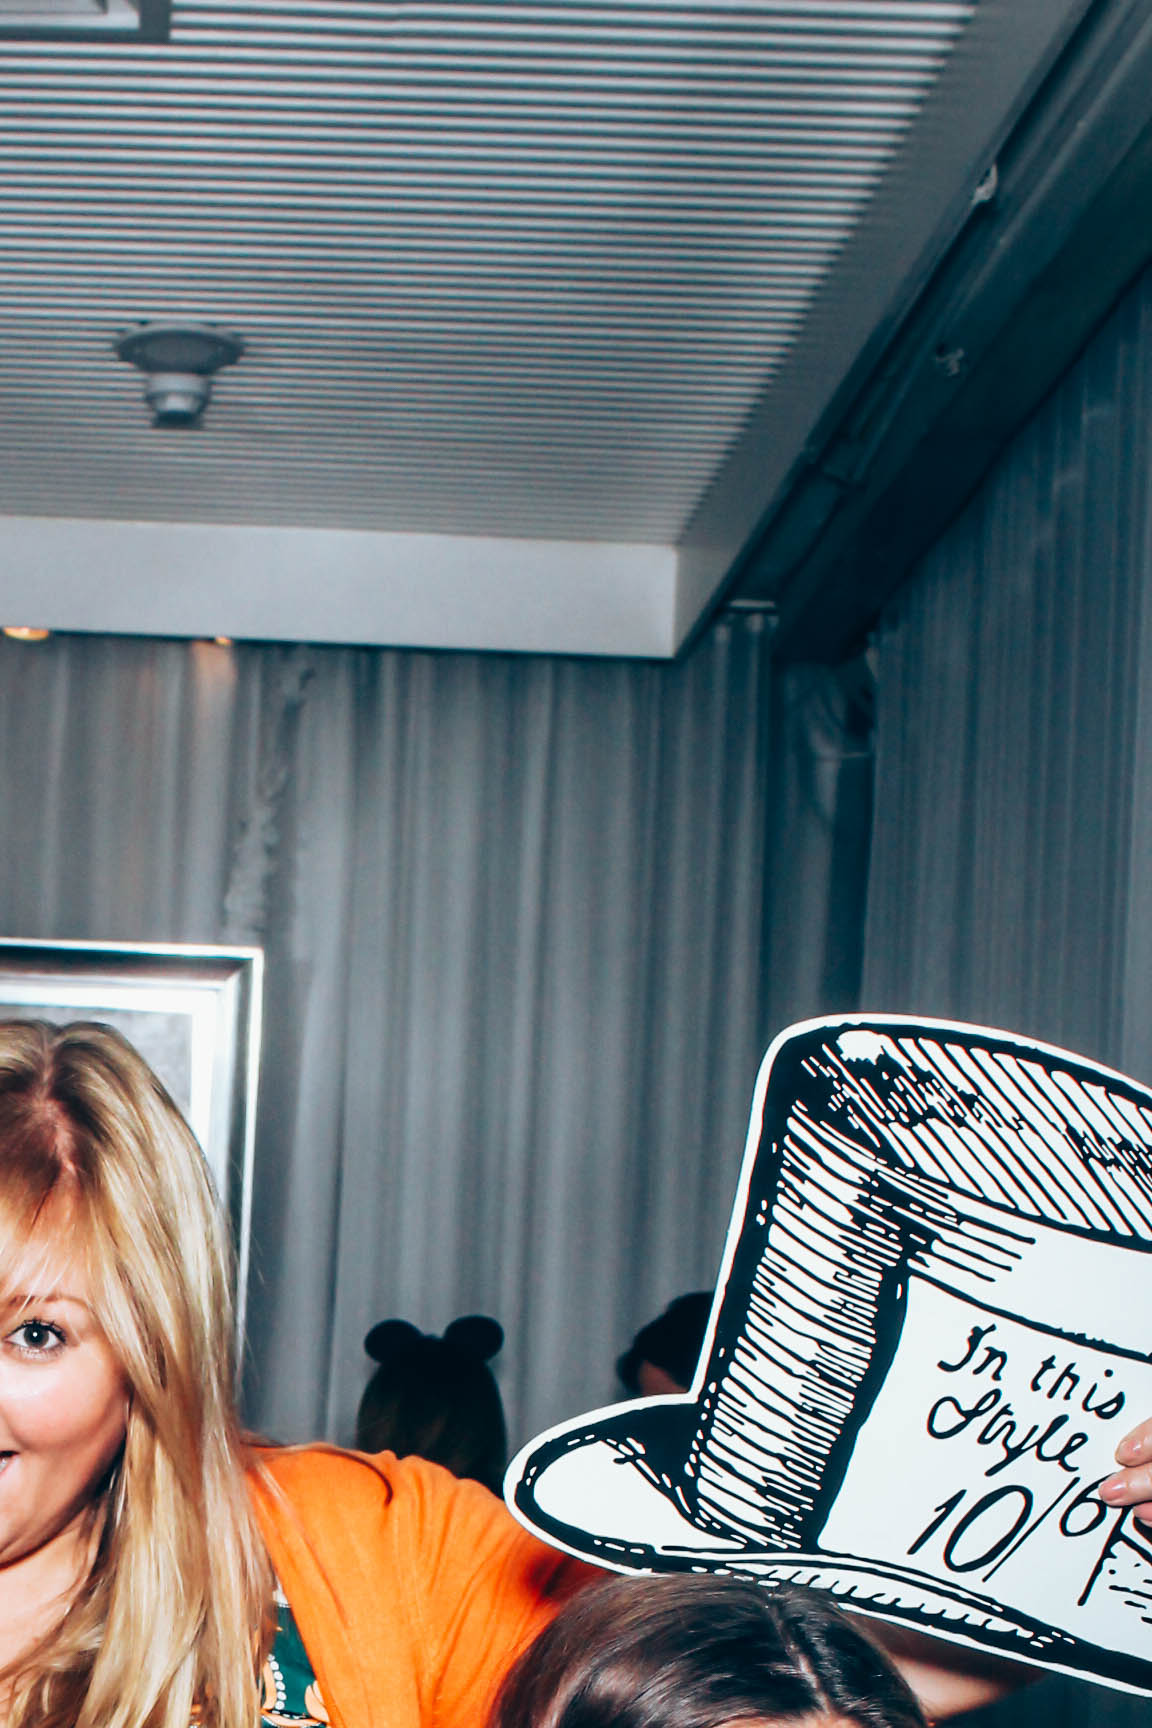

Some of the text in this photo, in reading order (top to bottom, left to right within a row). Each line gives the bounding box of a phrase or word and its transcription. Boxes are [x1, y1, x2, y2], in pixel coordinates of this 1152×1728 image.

[937, 1324, 1125, 1420] In this
[927, 1388, 1089, 1476] Style
[907, 1472, 1115, 1582] 10/6
